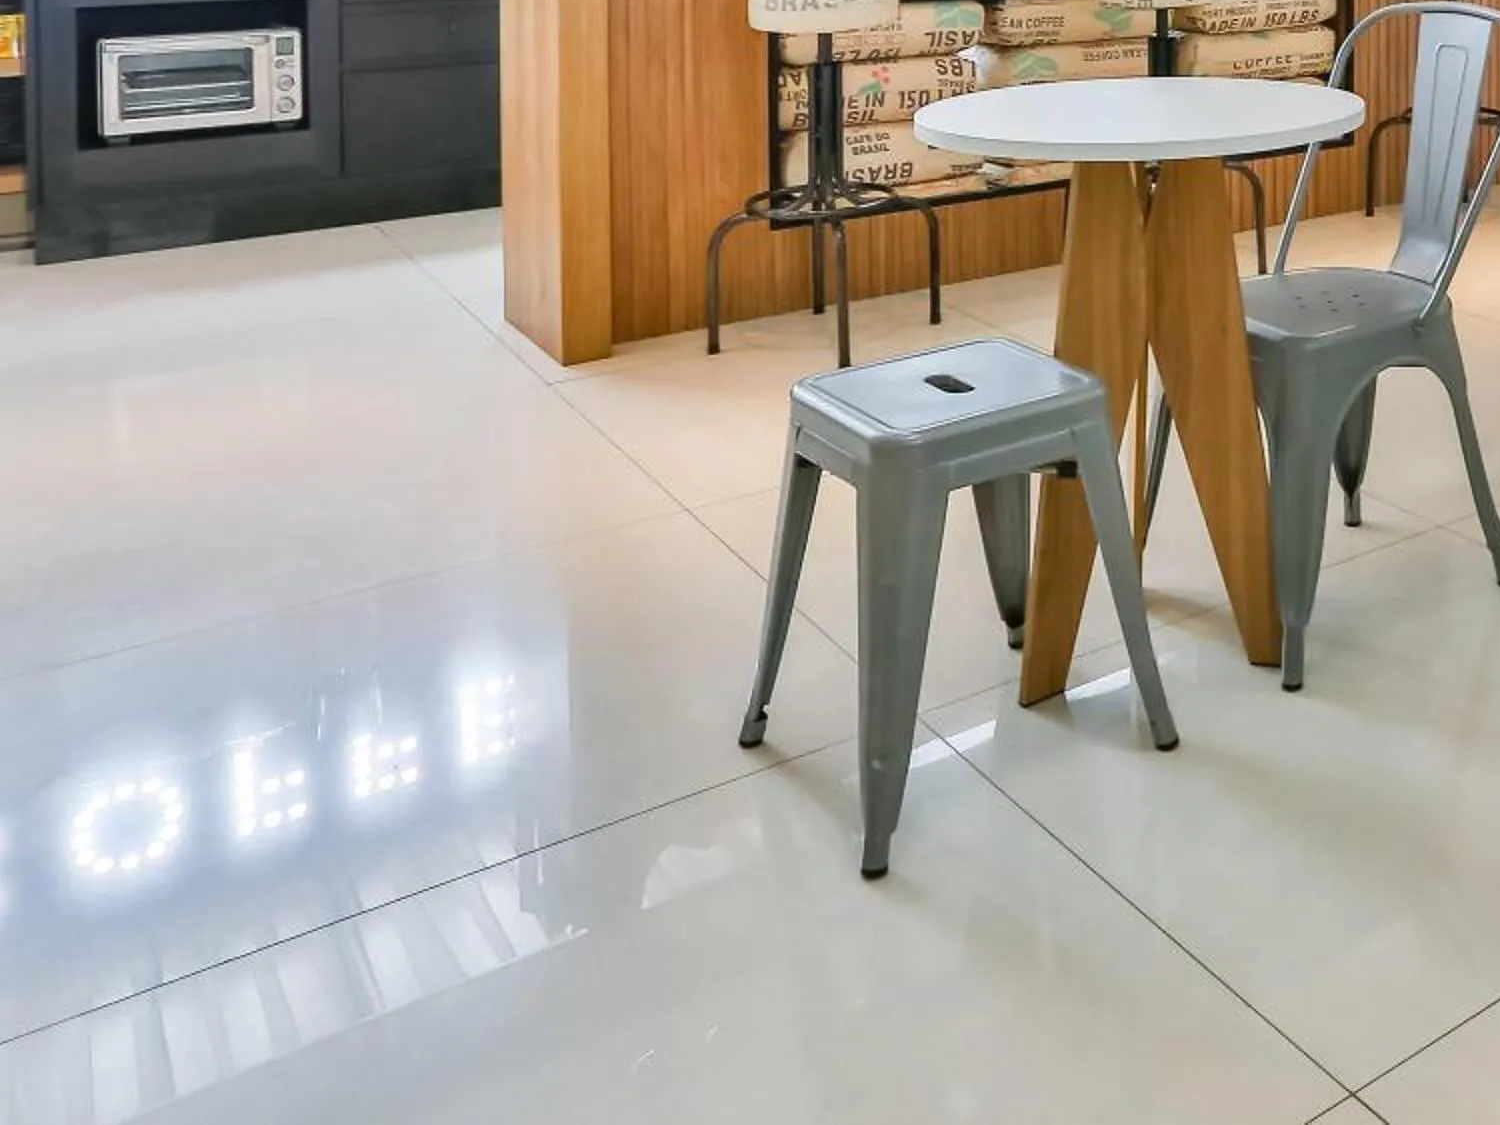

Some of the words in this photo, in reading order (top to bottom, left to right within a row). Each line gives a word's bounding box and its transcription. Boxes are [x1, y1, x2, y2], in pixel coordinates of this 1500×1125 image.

[1000, 17, 1023, 29] EAN
[1025, 15, 1066, 29] COFFEE
[1240, 15, 1257, 29] IN
[1289, 9, 1320, 25] LBS
[864, 91, 885, 108] IN
[846, 161, 914, 183] BRASI
